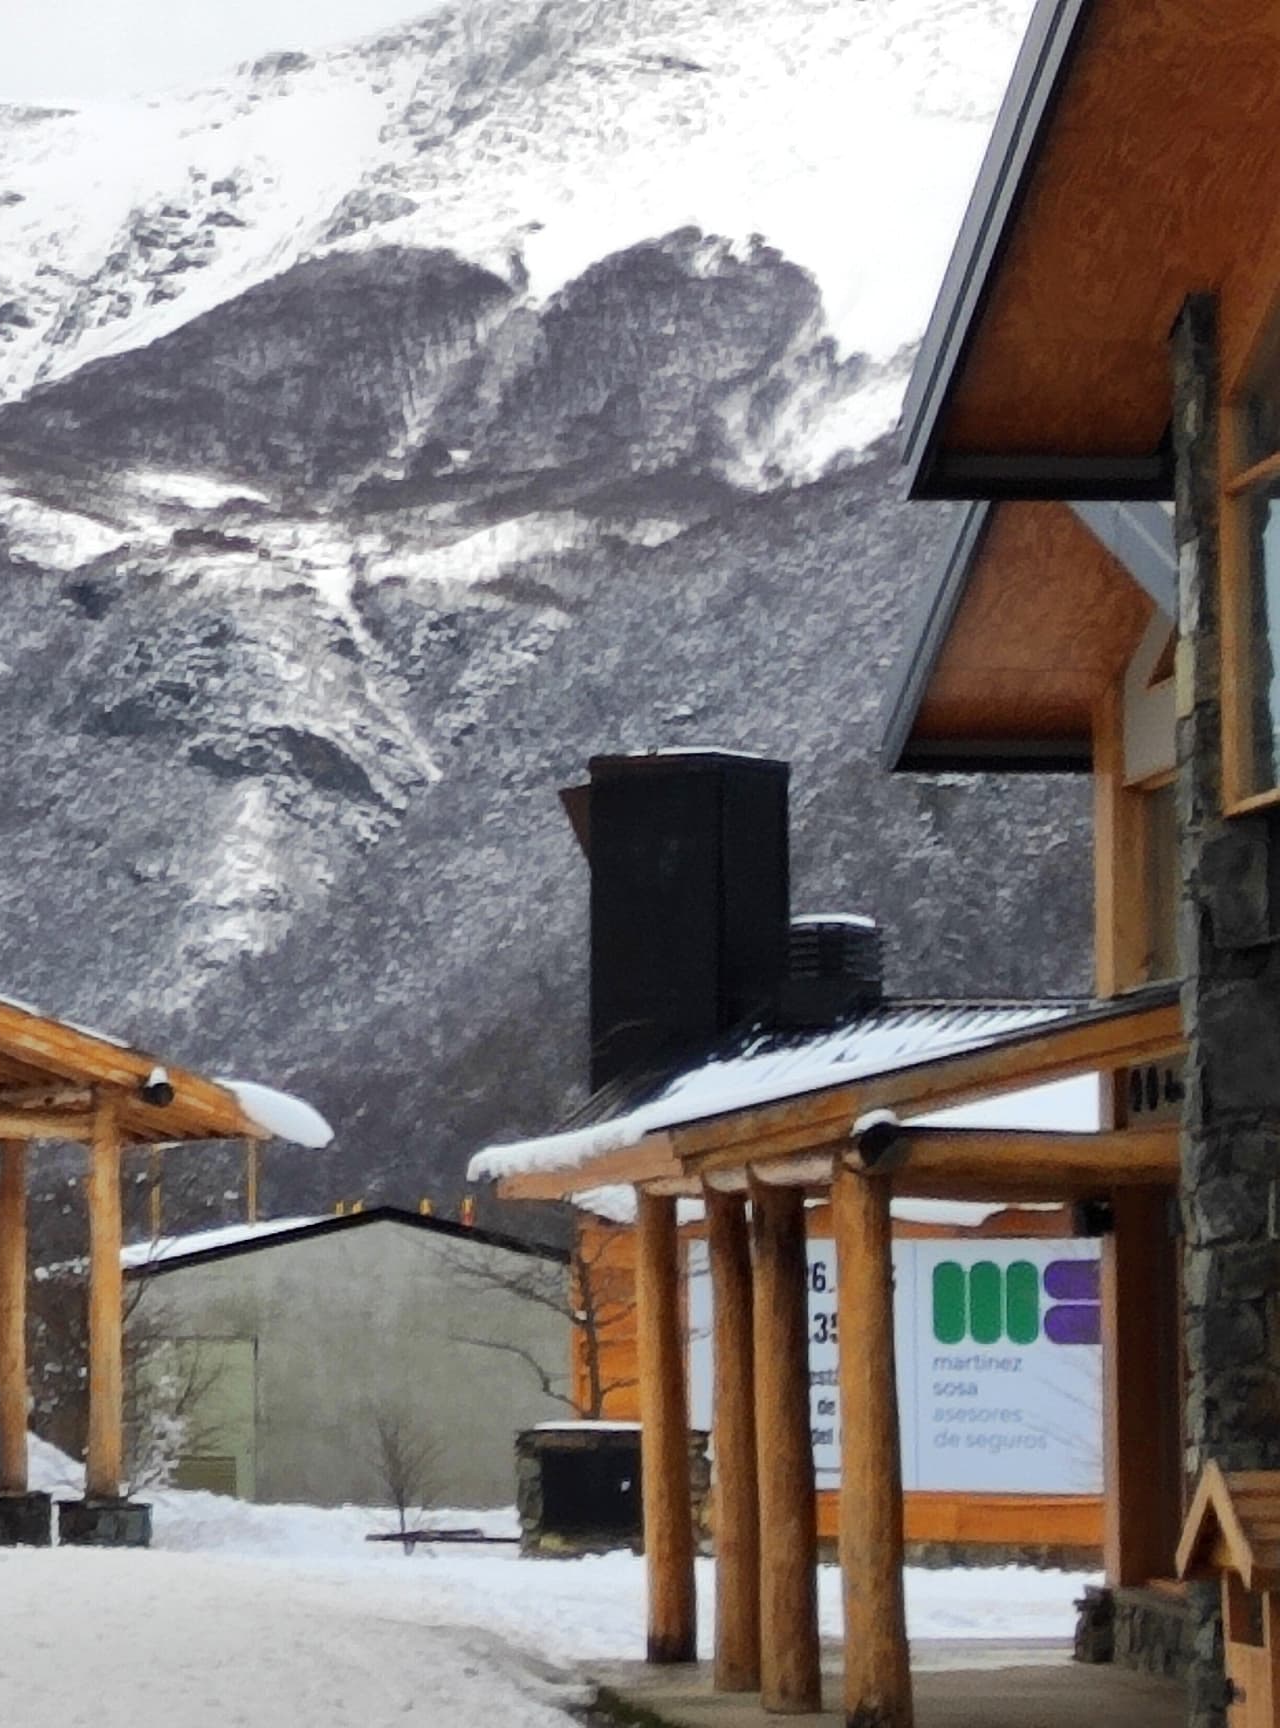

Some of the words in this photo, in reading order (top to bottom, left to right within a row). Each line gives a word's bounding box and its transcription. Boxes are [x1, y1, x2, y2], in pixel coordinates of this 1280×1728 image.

[932, 1354, 1023, 1372] martinez
[932, 1381, 978, 1397] sosa
[932, 1407, 1024, 1423] asesores
[933, 1428, 961, 1449] de
[965, 1432, 1048, 1455] seguros
